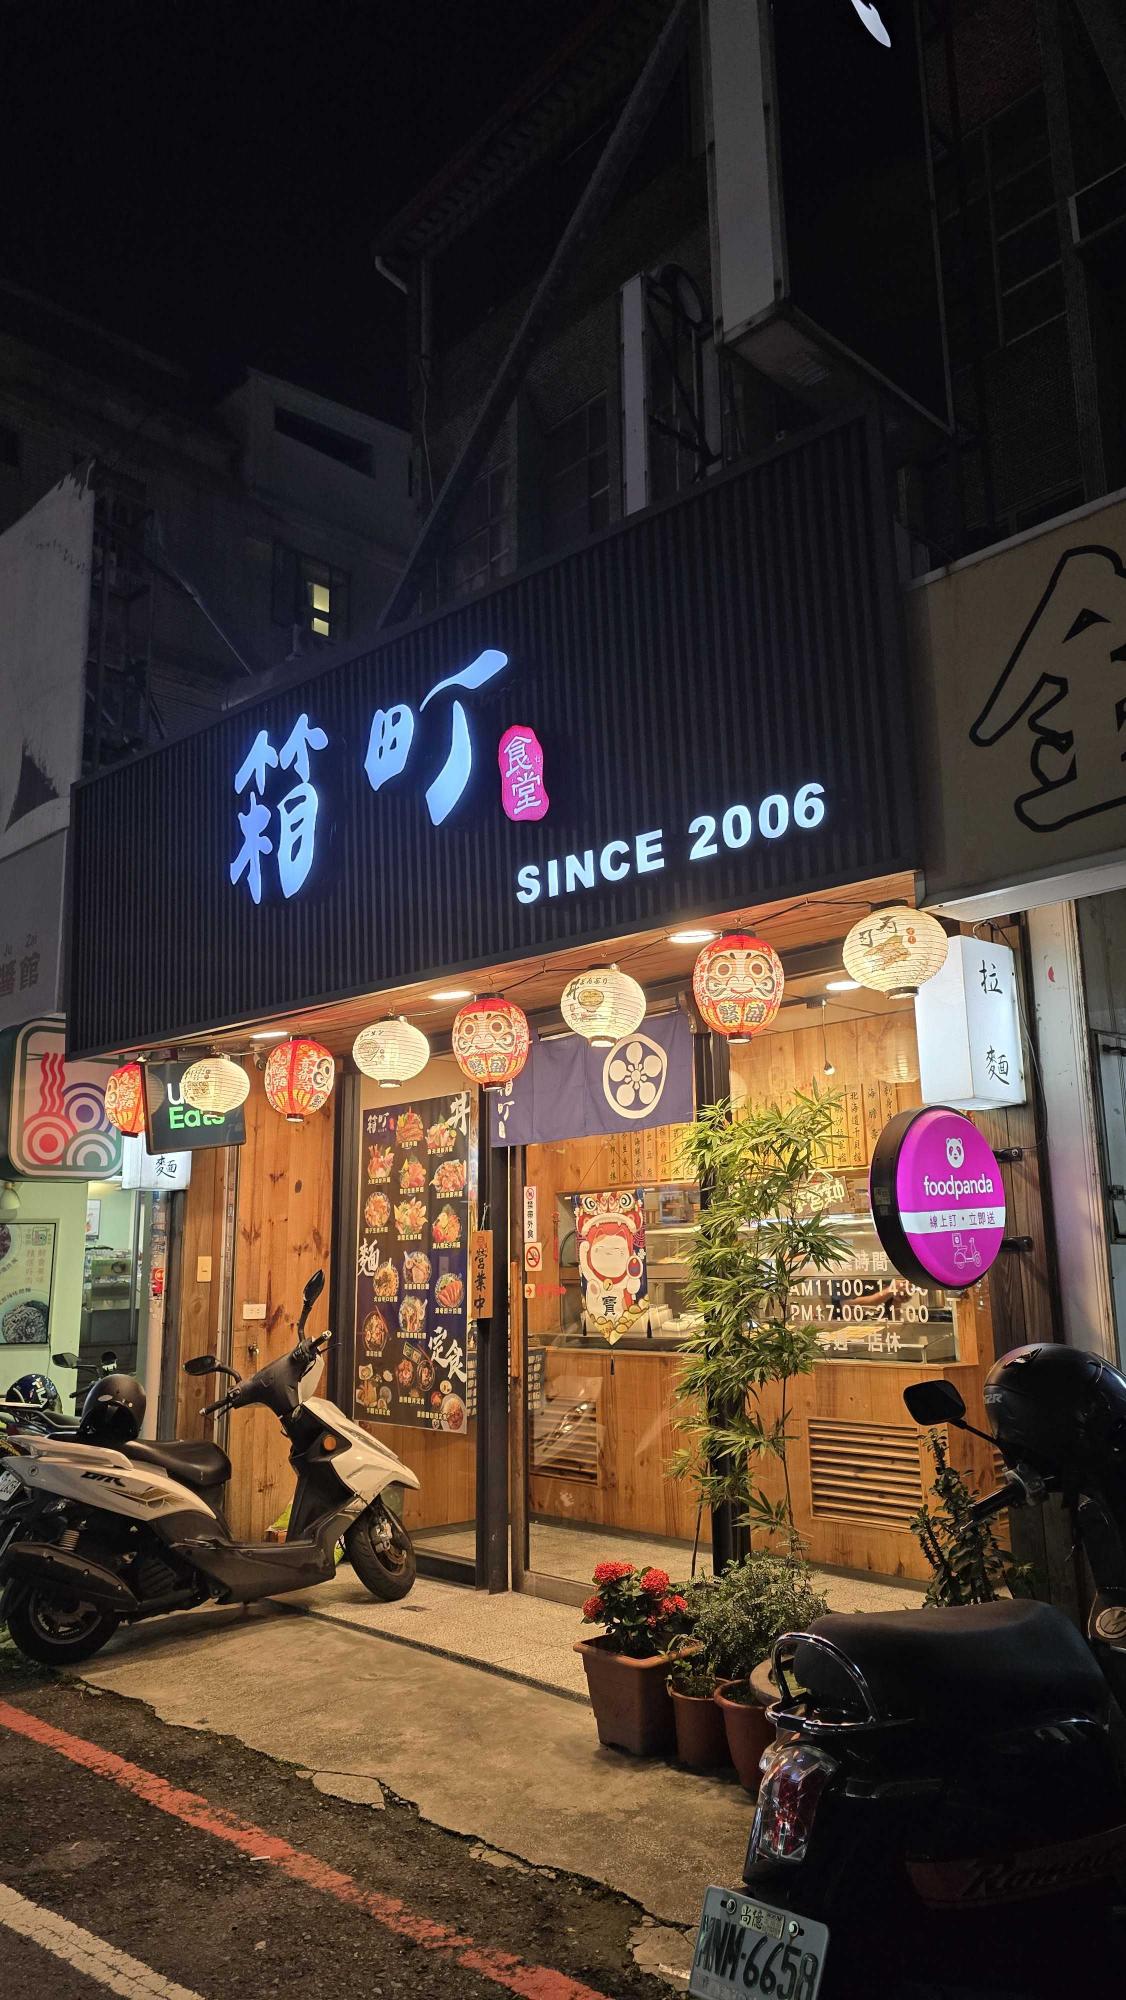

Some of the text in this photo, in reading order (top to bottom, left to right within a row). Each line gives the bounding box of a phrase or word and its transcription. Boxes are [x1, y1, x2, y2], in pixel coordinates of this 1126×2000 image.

[229, 649, 509, 905] 箱町
[503, 735, 542, 816] 食堂
[516, 782, 826, 905] SINCE 2006
[979, 960, 1010, 1086] 拉麵
[923, 1173, 994, 1200] foodpanda
[602, 1296, 617, 1316] 寶
